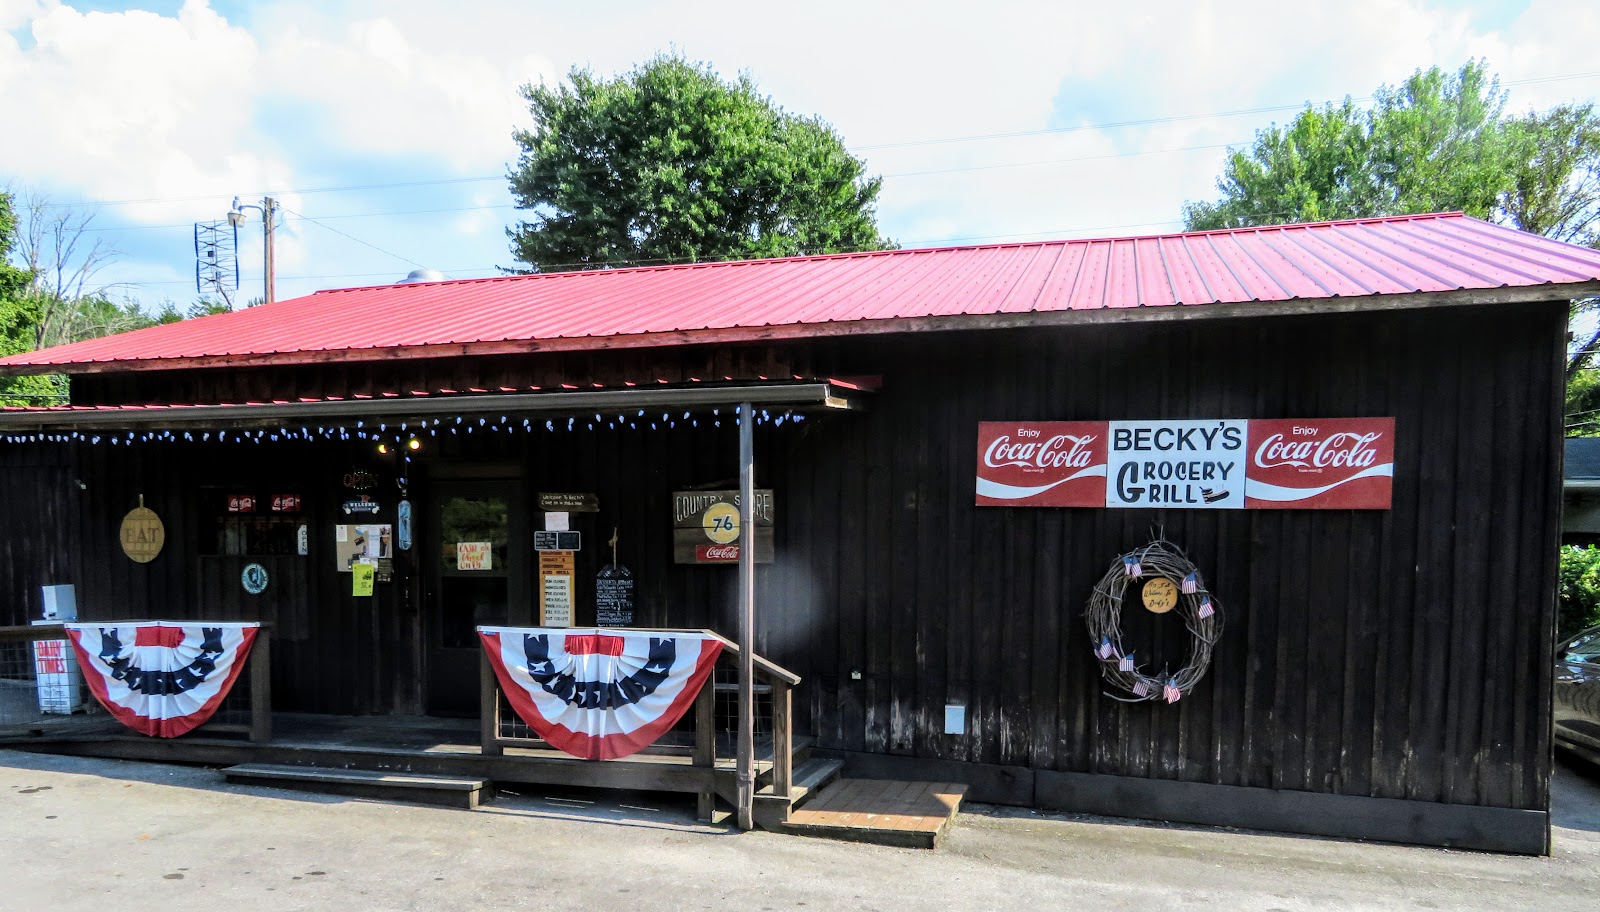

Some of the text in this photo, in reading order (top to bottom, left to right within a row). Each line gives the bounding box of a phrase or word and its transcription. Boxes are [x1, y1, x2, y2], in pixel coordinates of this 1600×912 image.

[1018, 428, 1041, 438] Enjoy
[1113, 421, 1242, 451] BECKY'S
[1292, 426, 1318, 436] Enjoy
[984, 434, 1098, 468] Coca-Cola
[1254, 431, 1383, 468] Coca-Cola
[676, 495, 723, 522] COUNTRY
[713, 515, 733, 532] 76
[125, 527, 160, 543] EAT
[37, 641, 61, 657] DAILY
[38, 658, 65, 674] TIMES
